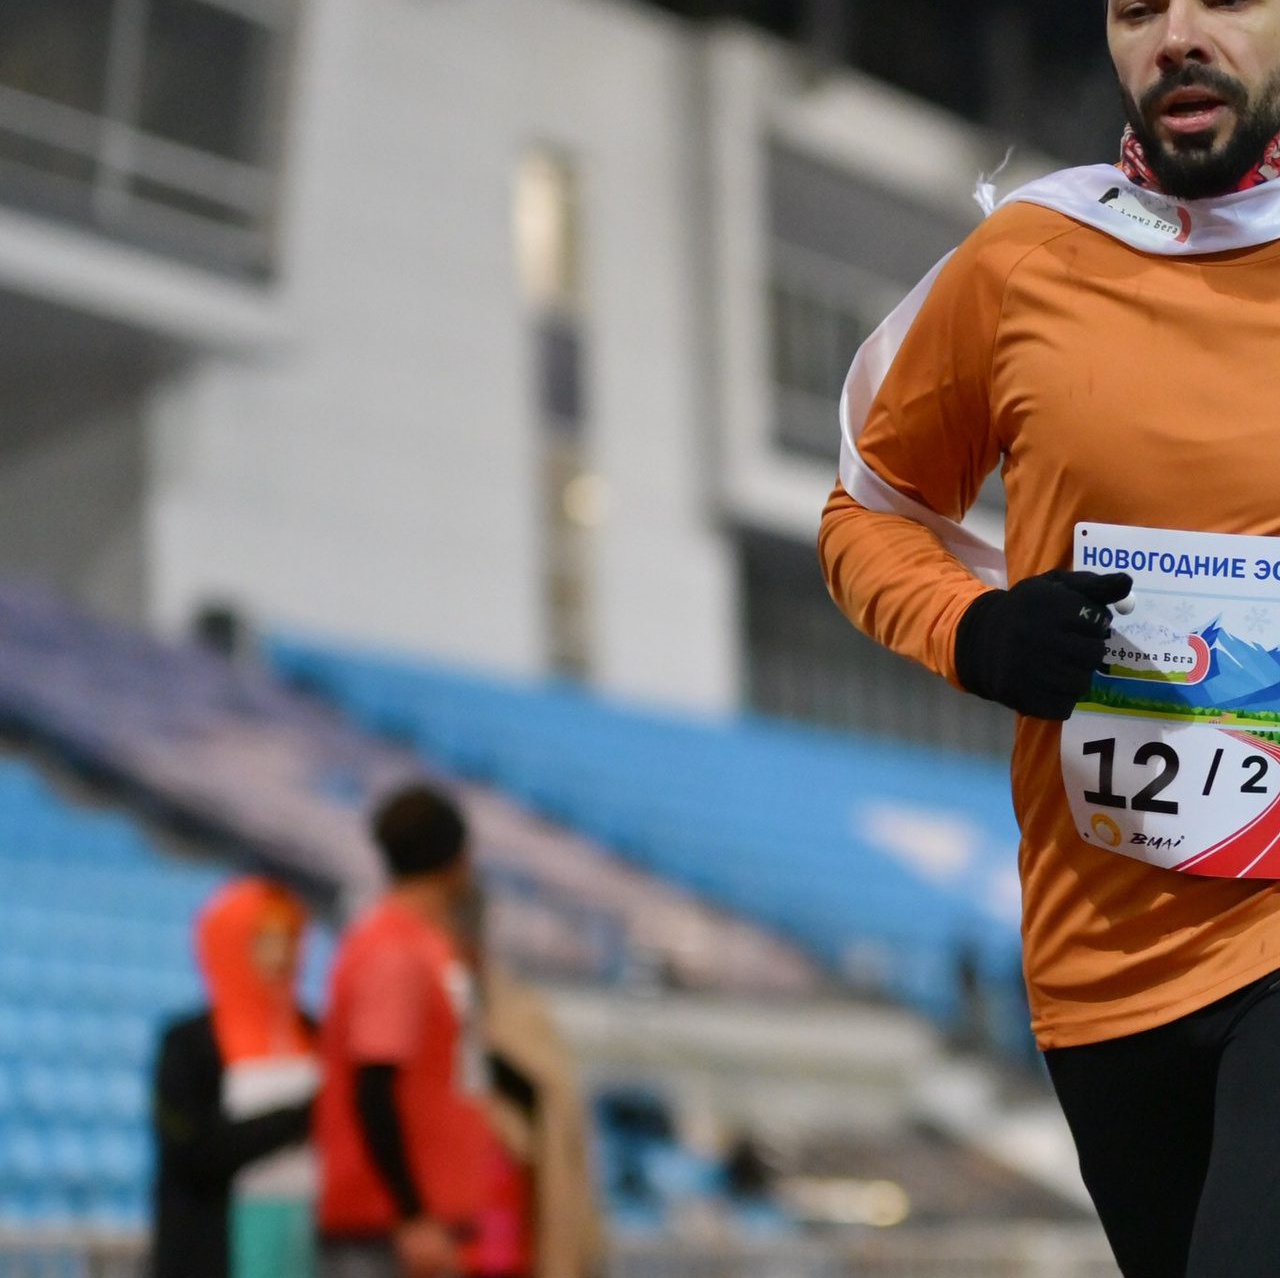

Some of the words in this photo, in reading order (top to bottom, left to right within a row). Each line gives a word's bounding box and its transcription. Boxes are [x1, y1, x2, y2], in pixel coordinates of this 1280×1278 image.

[1153, 220, 1178, 235] Бега
[1083, 546, 1246, 578] НОВОГОДНИЕ
[1104, 647, 1158, 662] Реформа
[1163, 652, 1194, 664] Бега
[1083, 738, 1180, 815] 12
[1240, 755, 1269, 794] 2
